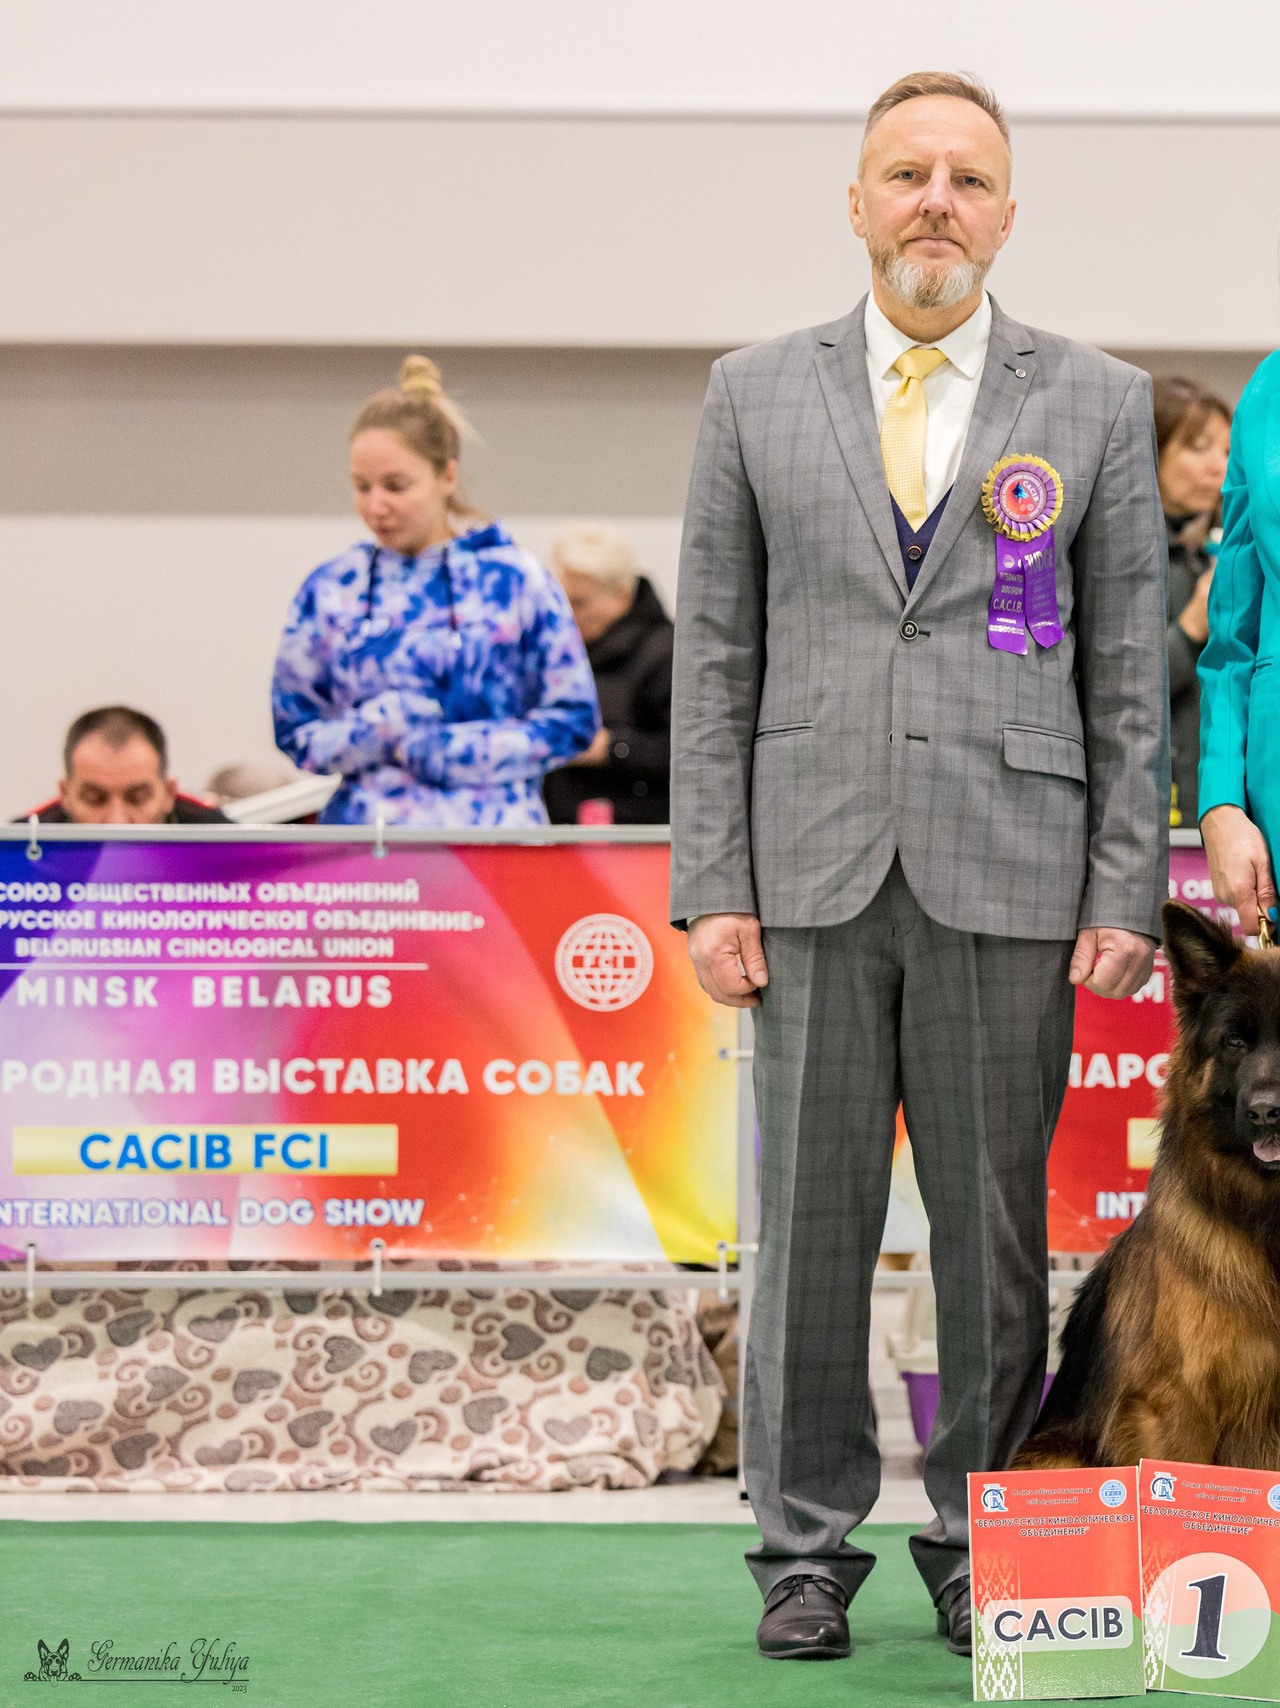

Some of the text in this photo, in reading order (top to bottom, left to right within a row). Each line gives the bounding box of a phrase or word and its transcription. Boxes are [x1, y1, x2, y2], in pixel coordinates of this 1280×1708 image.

[1022, 480, 1040, 502] CACIB
[66, 881, 251, 905] ОБЩЕСТВЕННЫХ
[257, 878, 420, 905] ОБЪЕДИНЕНИЙ
[103, 909, 308, 931] КИНОЛОГИЧЕСКОЕ
[15, 937, 394, 958] BELORUSSIAN CINOLOGICAL UNION
[17, 975, 393, 1008] MINSK BELARUS
[213, 1057, 469, 1095] ВЫСТАВКА
[482, 1058, 645, 1096] СОБАК
[79, 1133, 328, 1170] CACIB FCI
[239, 1199, 315, 1226] DOG
[324, 1198, 425, 1226] SHOW
[1011, 1487, 1093, 1496] Союз общественных
[1194, 1493, 1247, 1503] объединений
[1203, 1482, 1262, 1495] общественных
[1026, 1497, 1079, 1506] объединений
[1048, 1513, 1135, 1525] КИНОЛОГИЧЕСКОЕ
[994, 1607, 1124, 1642] CACIB
[1182, 1575, 1228, 1661] 1
